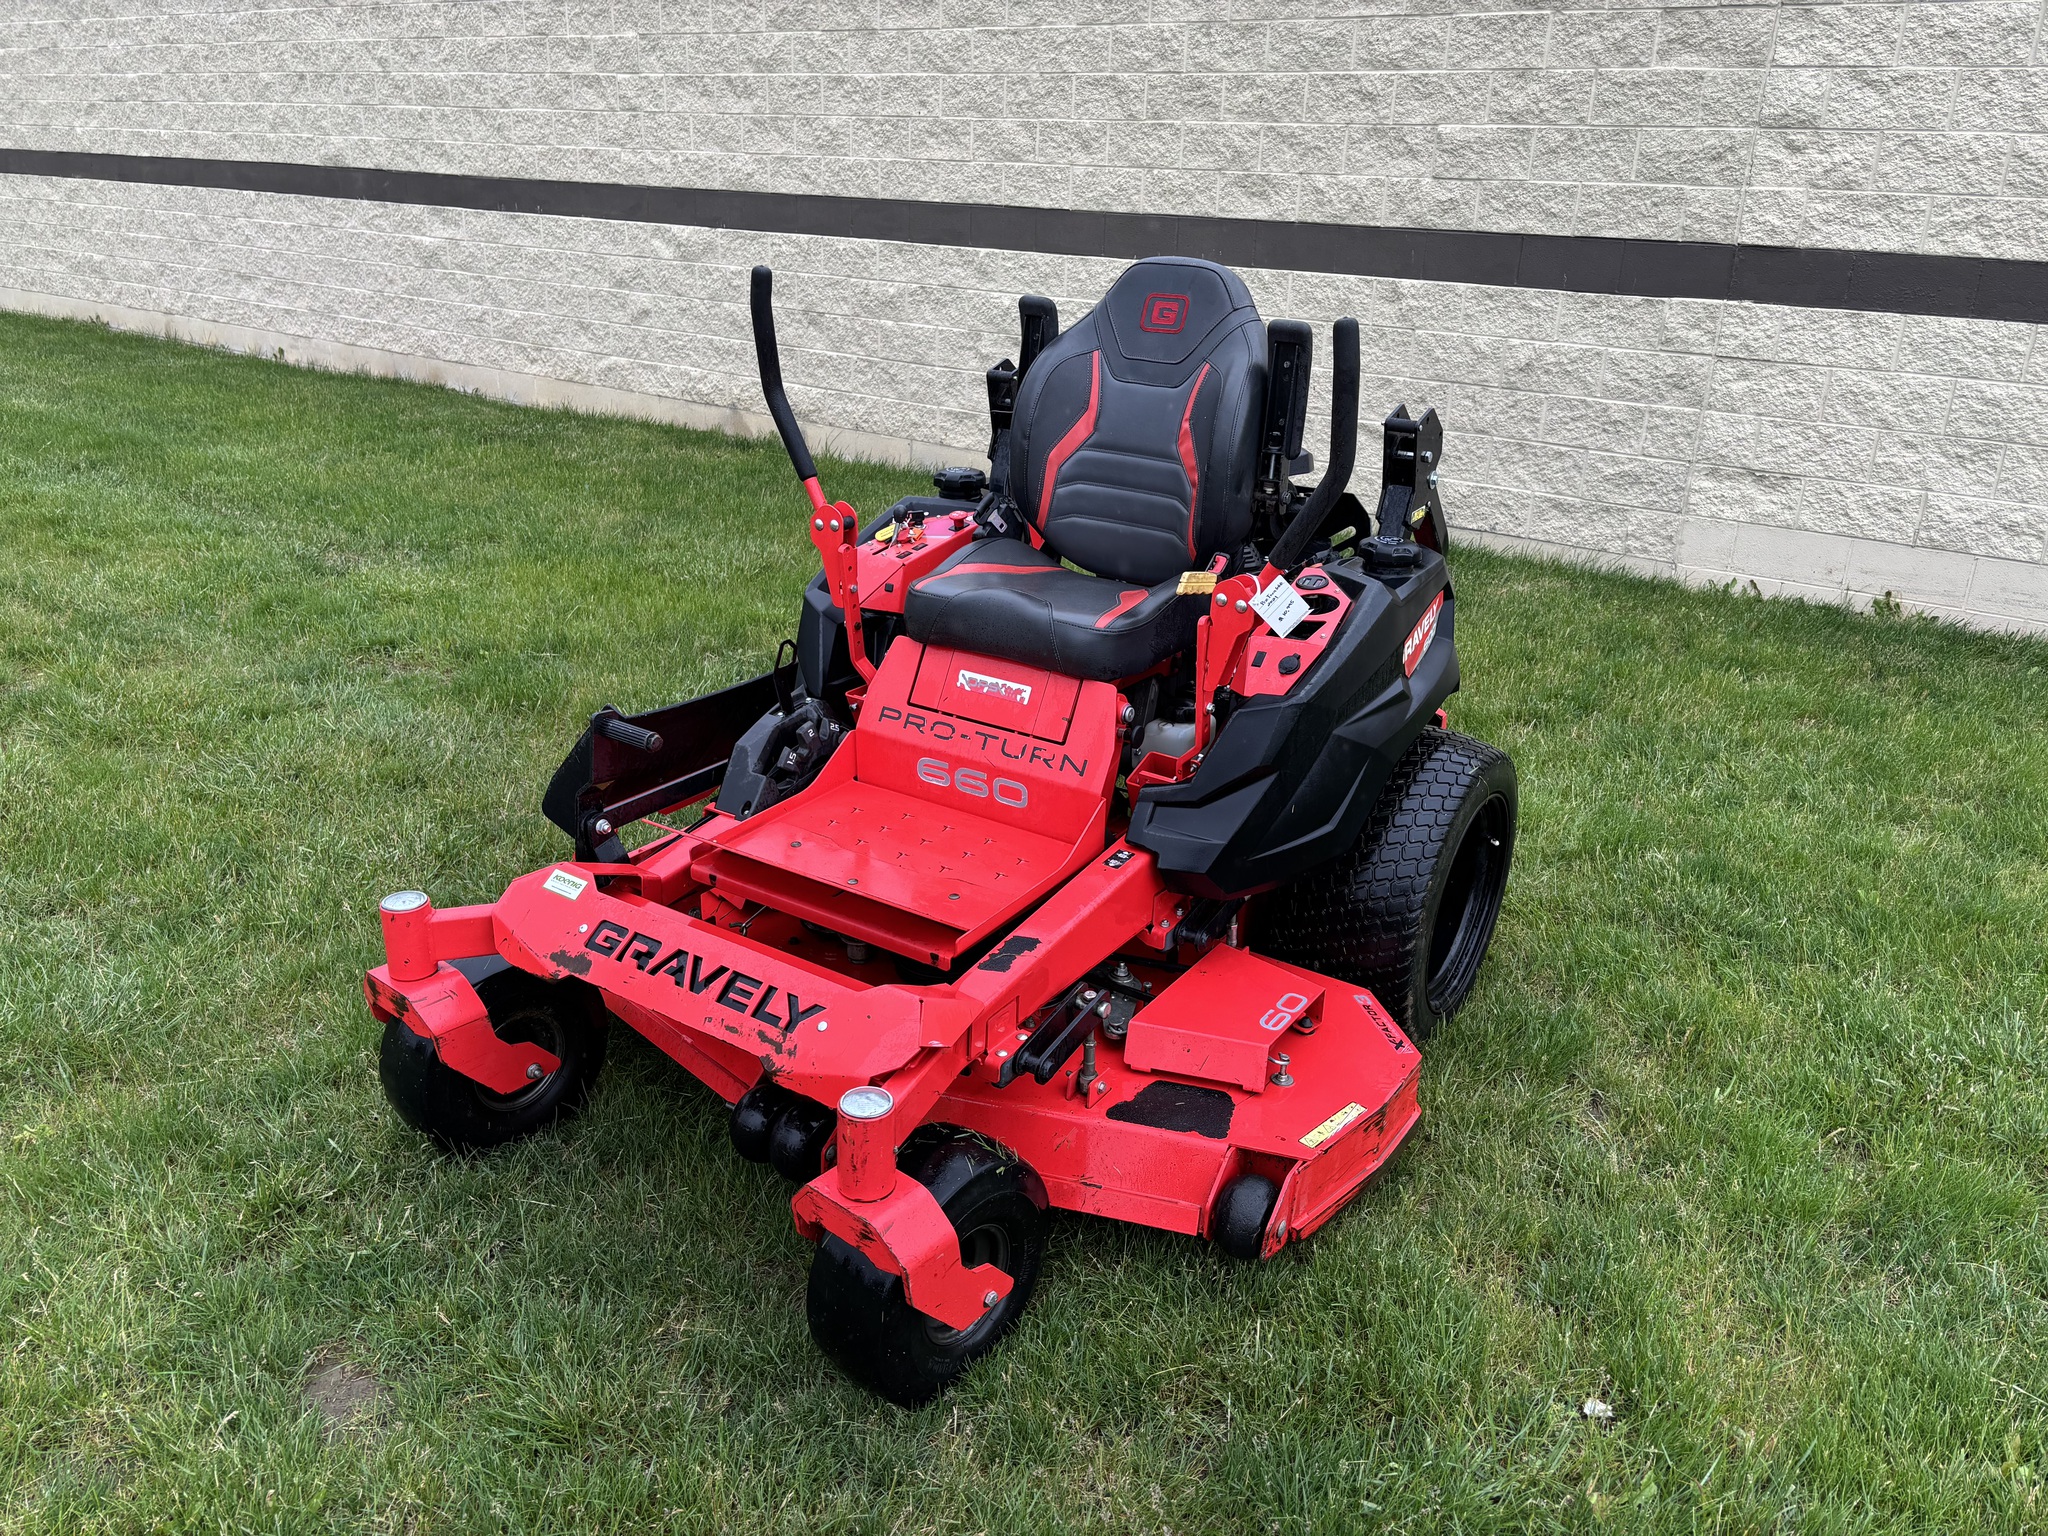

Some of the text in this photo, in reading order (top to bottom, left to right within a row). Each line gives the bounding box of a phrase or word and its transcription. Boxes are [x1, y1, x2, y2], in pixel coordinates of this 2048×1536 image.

[1403, 598, 1439, 664] RAVELY
[807, 728, 815, 737] 2
[878, 706, 1088, 777] PRO-TURN
[916, 757, 1028, 808] 660
[584, 919, 827, 1035] GRAVELY
[1259, 992, 1308, 1031] 60
